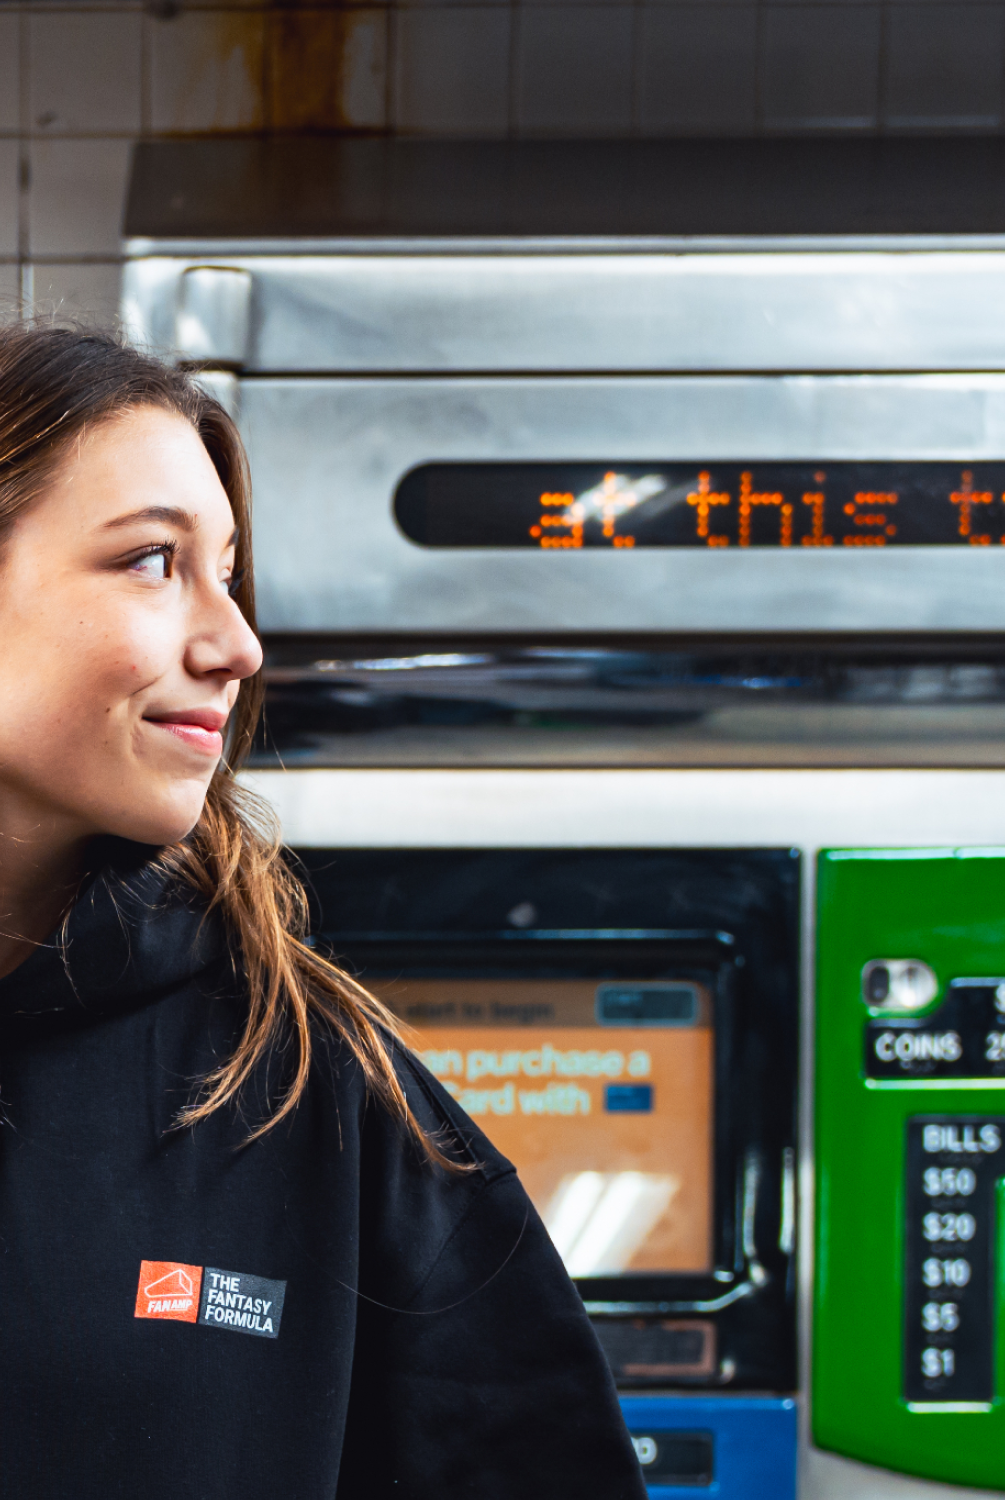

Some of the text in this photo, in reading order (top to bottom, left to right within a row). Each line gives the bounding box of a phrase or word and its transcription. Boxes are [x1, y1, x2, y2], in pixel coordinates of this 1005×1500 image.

[529, 470, 1005, 548] at this t
[875, 1031, 963, 1062] COINS
[466, 1045, 624, 1082] purchase
[628, 1051, 650, 1077] a
[518, 1082, 591, 1115] with
[923, 1124, 1001, 1152] BILLS
[922, 1167, 976, 1196] $50
[922, 1212, 976, 1241] $20
[210, 1273, 241, 1292] THE
[922, 1258, 971, 1287] $10
[147, 1299, 193, 1313] FANAMP
[207, 1289, 272, 1316] FANTASY
[205, 1305, 273, 1333] FORMULA
[921, 1303, 960, 1332] $5
[921, 1348, 955, 1377] $1
